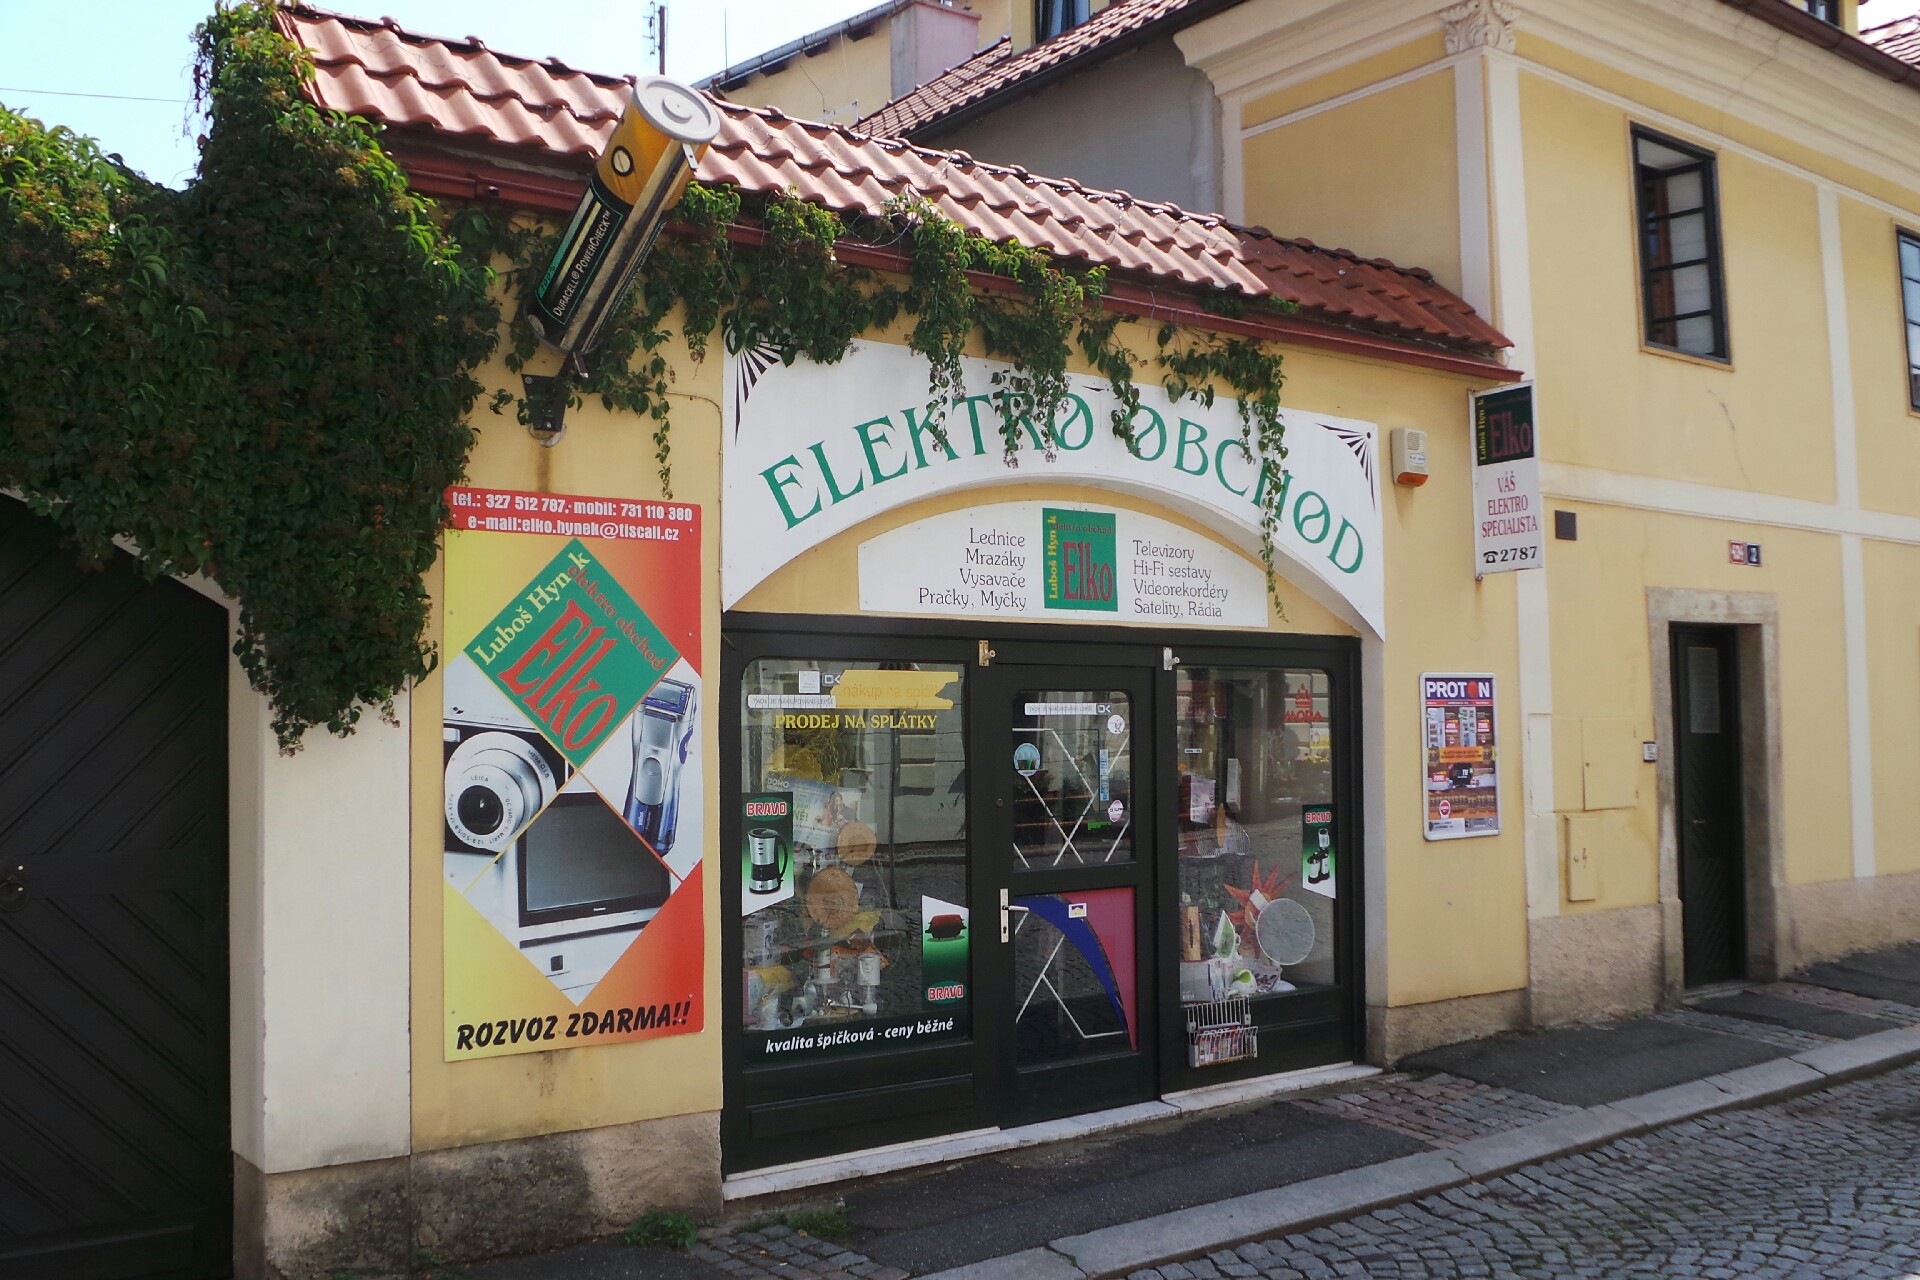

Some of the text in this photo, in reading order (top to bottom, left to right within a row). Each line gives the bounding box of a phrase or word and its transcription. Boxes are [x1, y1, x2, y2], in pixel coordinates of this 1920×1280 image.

[1490, 410, 1532, 459] Elko
[758, 391, 1364, 574] ELEKTRO OBCHOD
[1497, 470, 1516, 493] VÁŠ
[452, 491, 480, 507] tel.:
[486, 494, 511, 509] 327
[515, 496, 538, 512] 512
[574, 501, 617, 516] mobil:
[621, 504, 642, 518] 731
[645, 505, 664, 519] 110
[1487, 495, 1529, 516] ELEKTRO
[969, 527, 1026, 548] Lednice
[1082, 525, 1113, 535] obchod
[1482, 515, 1538, 538] SPECIALISTA
[965, 547, 1026, 569] Mrazáky
[1133, 540, 1195, 560] Televizory
[1500, 546, 1538, 562] 2787
[959, 568, 1026, 590] Vysavače
[1048, 559, 1059, 600] Luboš
[1063, 540, 1113, 602] Elko
[1133, 560, 1212, 582] Hi-Fi sestavy
[918, 587, 1027, 612] Pračky, Myčky
[1133, 579, 1229, 602] Videorekordéry
[567, 565, 667, 670] elektro obchod
[1134, 598, 1222, 618] Satelity, Rádia
[473, 605, 533, 666] Luboš
[497, 599, 618, 751] Elko
[843, 683, 882, 701] nákup
[884, 687, 900, 697] na
[775, 711, 937, 729] PRODEJ NA SPLÁTKY
[1283, 710, 1327, 723] MORA
[746, 801, 787, 817] BRAVO
[1305, 811, 1332, 824] BRAVO
[928, 984, 964, 1001] BRAVO
[456, 1001, 691, 1051] ROZVOZ ZDARMA!!
[765, 1036, 814, 1054] kvalita
[817, 1027, 874, 1050] špičková
[885, 1024, 914, 1041] ceny
[916, 1017, 954, 1035] běžné
